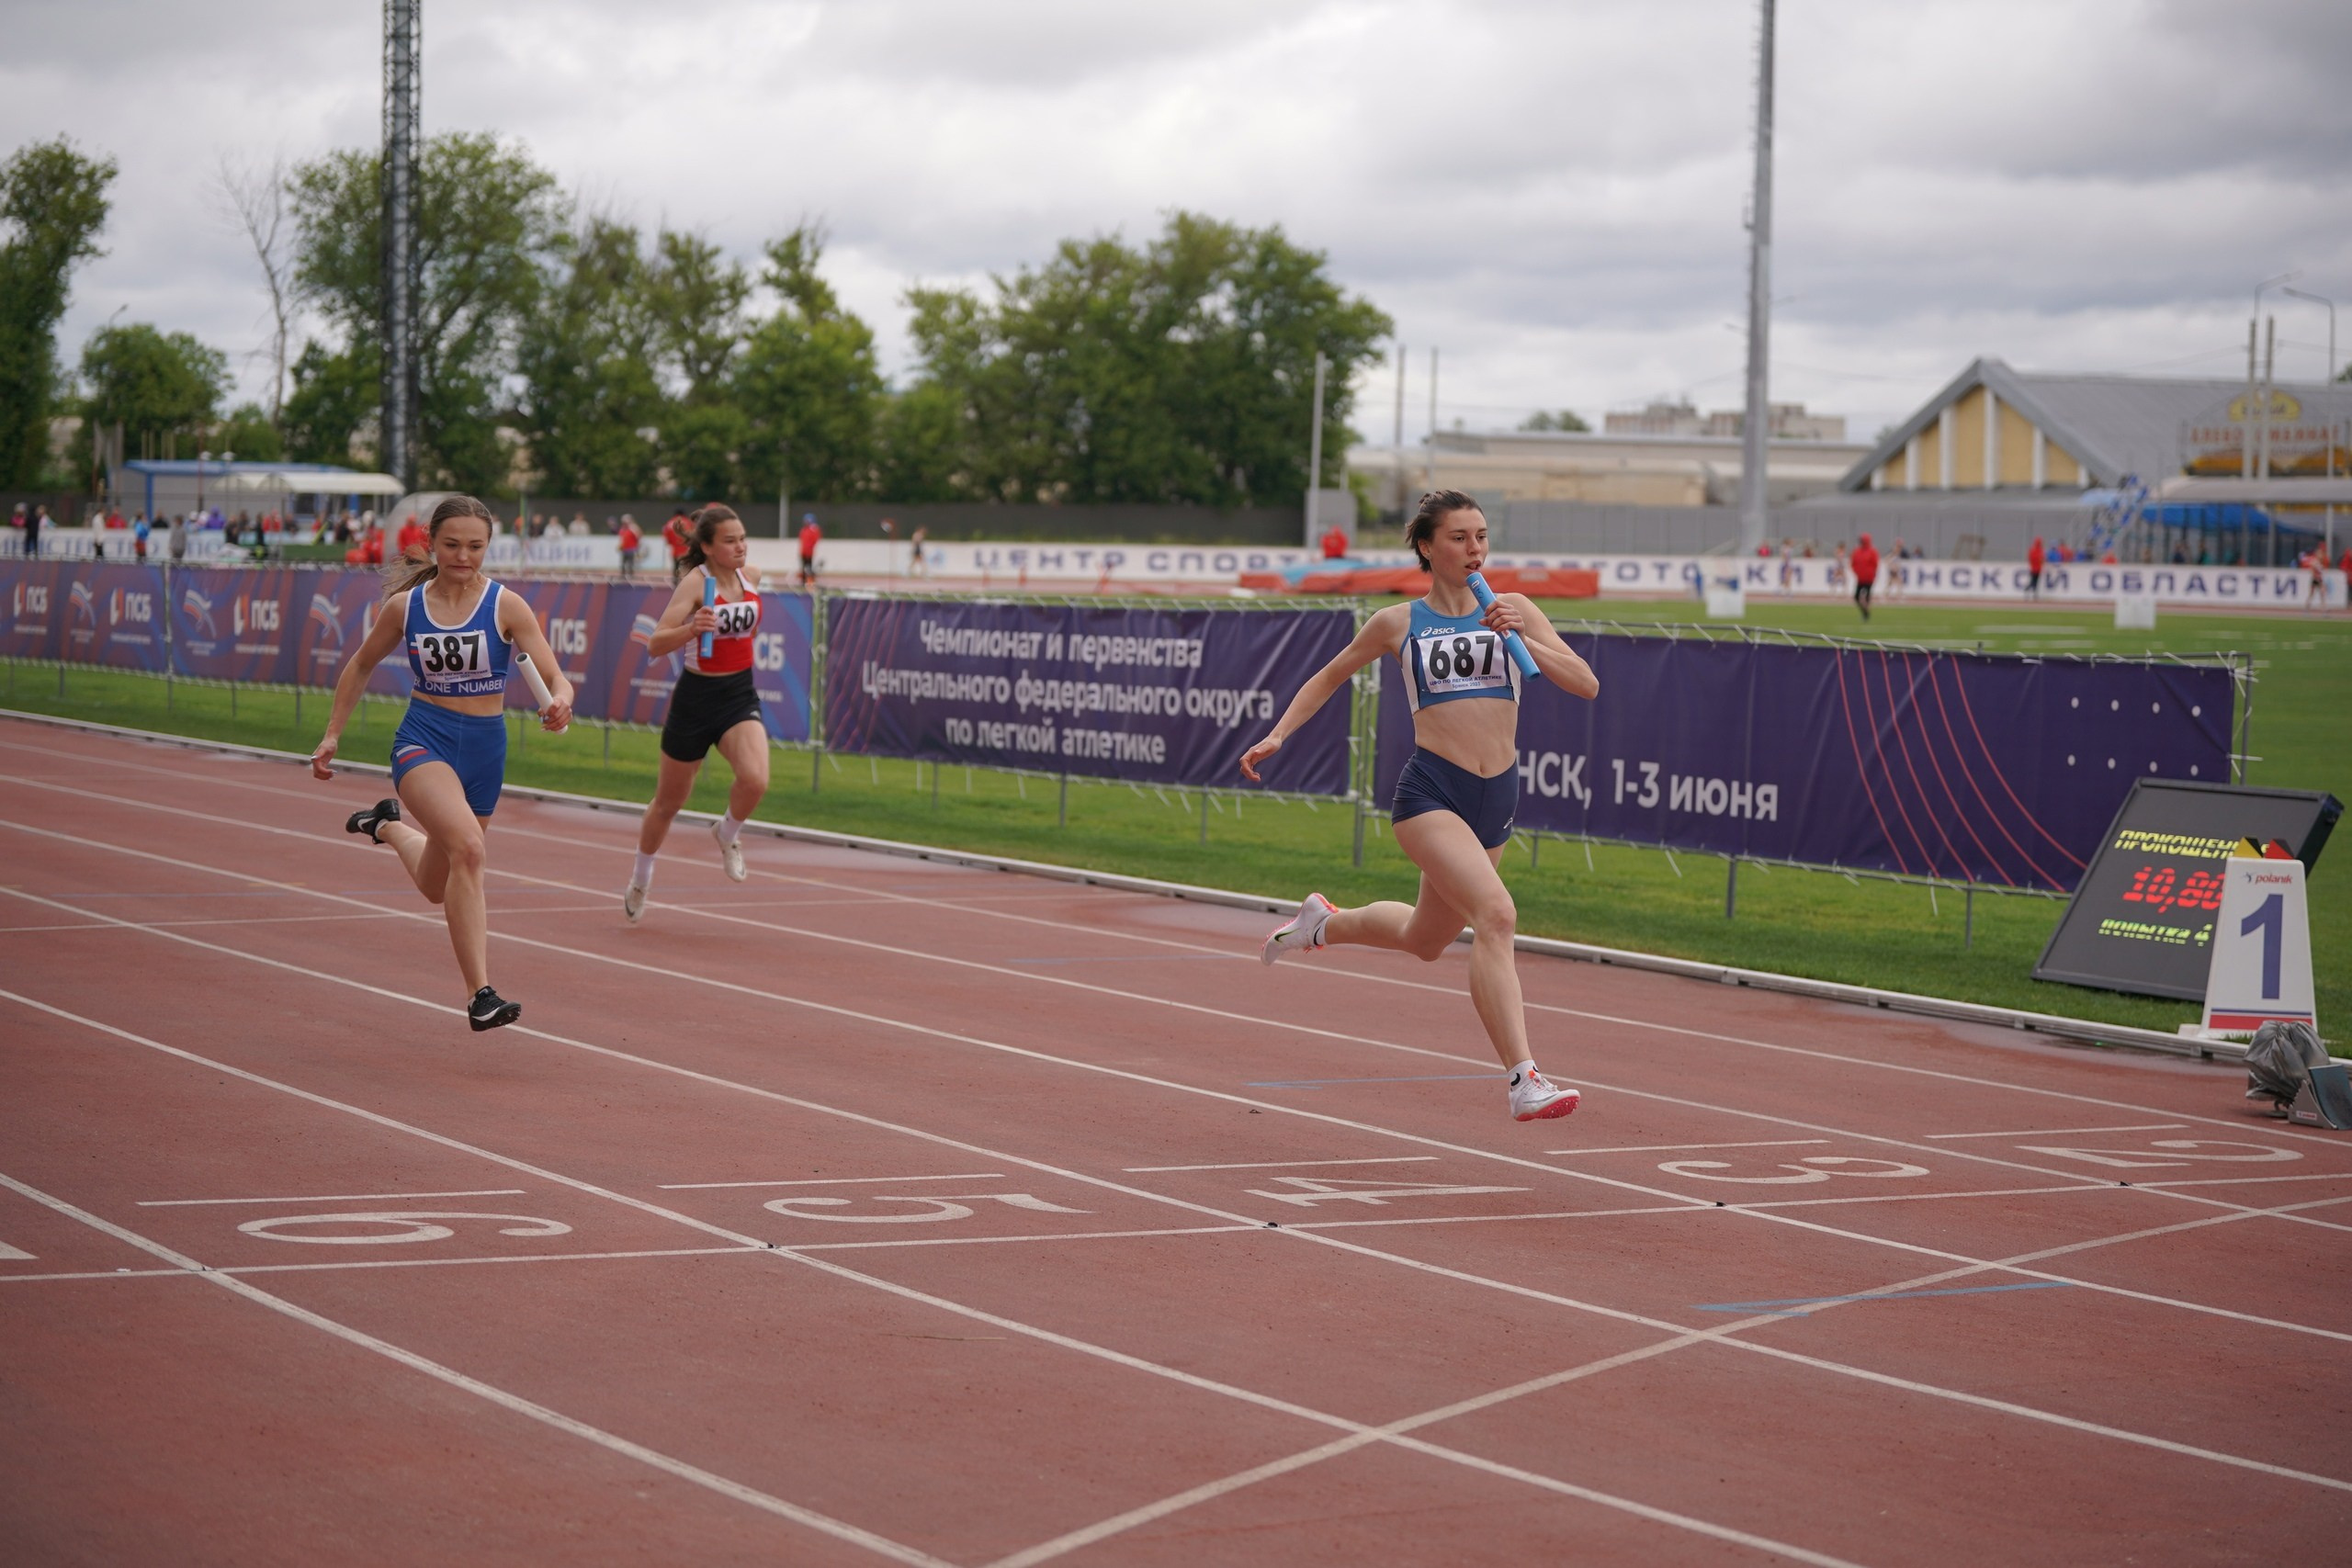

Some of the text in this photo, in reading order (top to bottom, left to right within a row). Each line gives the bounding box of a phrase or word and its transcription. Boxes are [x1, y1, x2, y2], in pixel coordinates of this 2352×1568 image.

[974, 549, 1126, 570] ЦЕНТР
[2090, 570, 2298, 596] ОБЛАСТИ
[125, 592, 152, 623] ПСБ
[251, 599, 280, 631] ПСБ
[718, 605, 755, 635] 360
[549, 617, 588, 655] ПСБ
[920, 619, 1204, 673] Чемпионат и первенства
[1431, 626, 1456, 636] asics
[423, 634, 480, 673] 387
[754, 632, 786, 671] СБ
[1429, 635, 1496, 681] 687
[424, 681, 451, 693] ONE
[458, 679, 503, 694] NUMBER
[862, 659, 1275, 729] Центрального федерального округа
[944, 716, 1166, 764] по легкой атлетике
[1516, 749, 1593, 810] НСК,
[1612, 758, 1660, 808] 1-3
[2255, 873, 2293, 885] polanik
[2240, 893, 2284, 1000] 1
